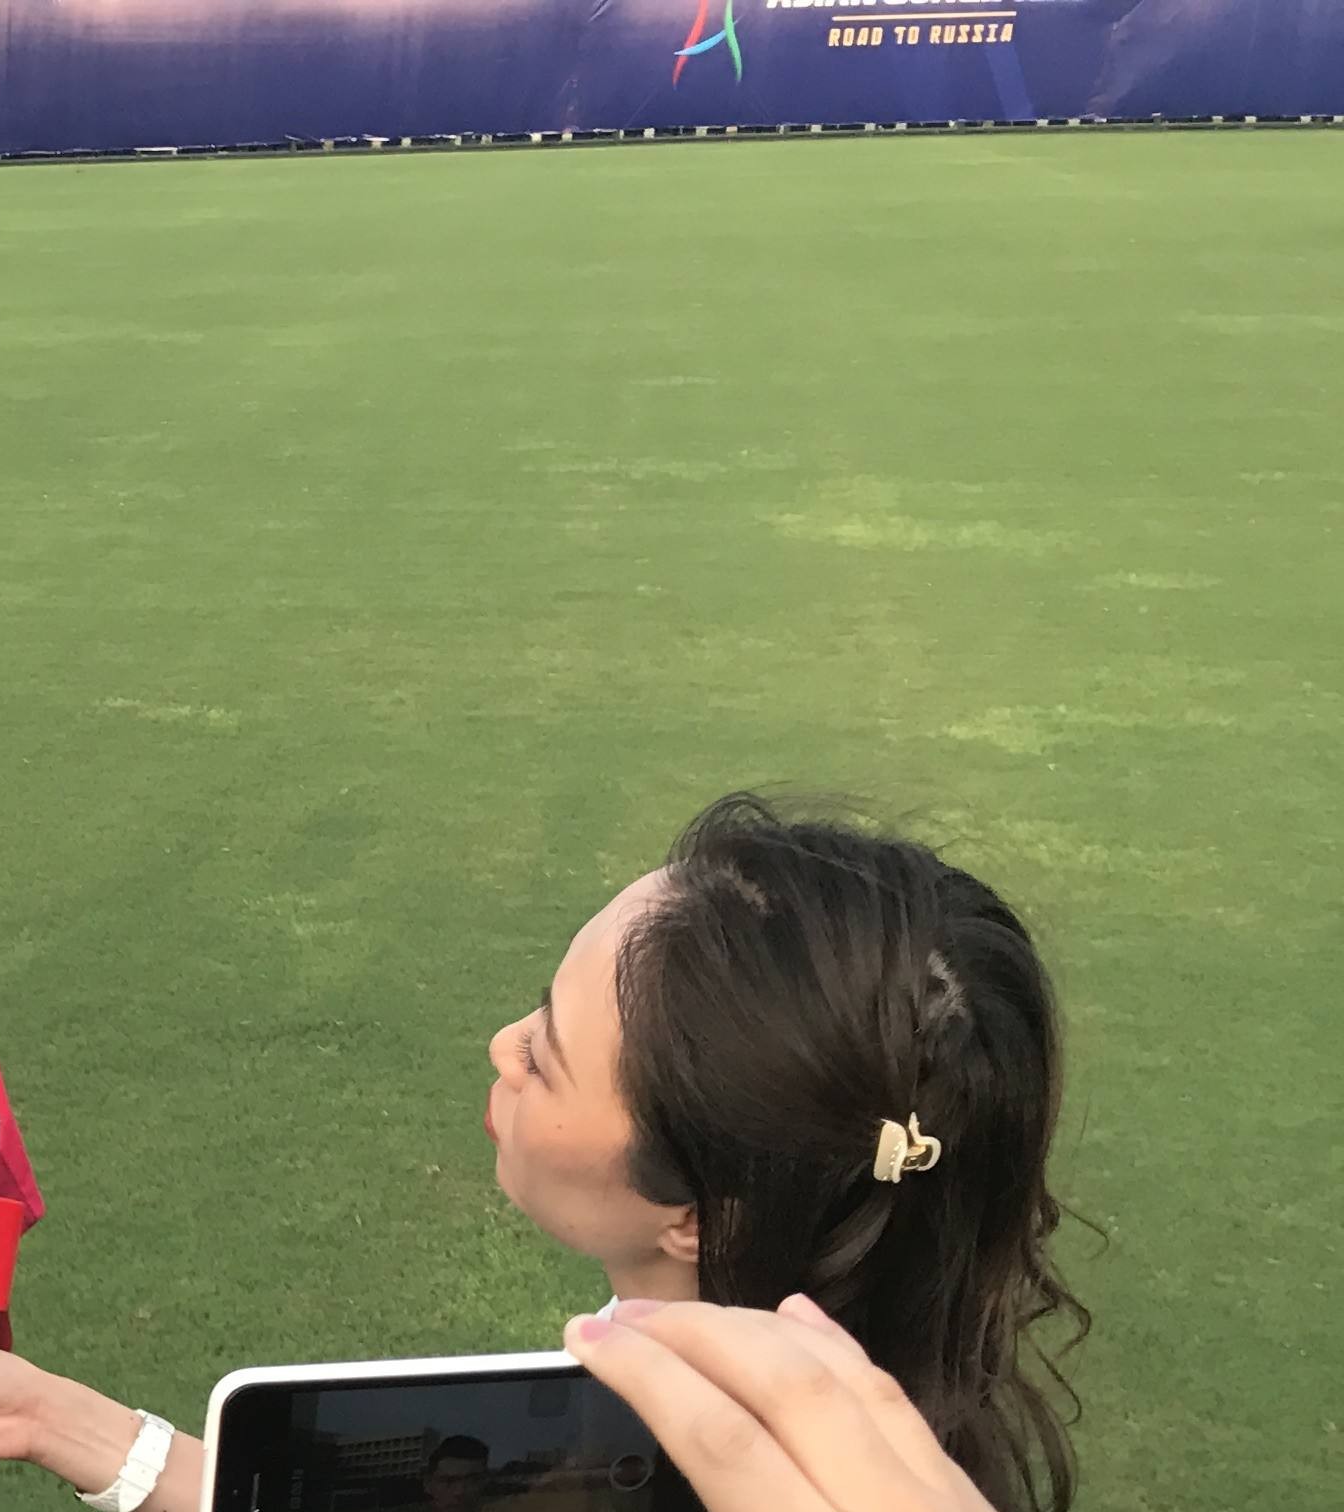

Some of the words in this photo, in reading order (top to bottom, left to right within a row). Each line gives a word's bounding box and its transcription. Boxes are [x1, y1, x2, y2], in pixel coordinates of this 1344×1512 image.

[828, 27, 883, 47] ROAD
[895, 26, 920, 45] TO
[930, 23, 1014, 44] RUSSIA
